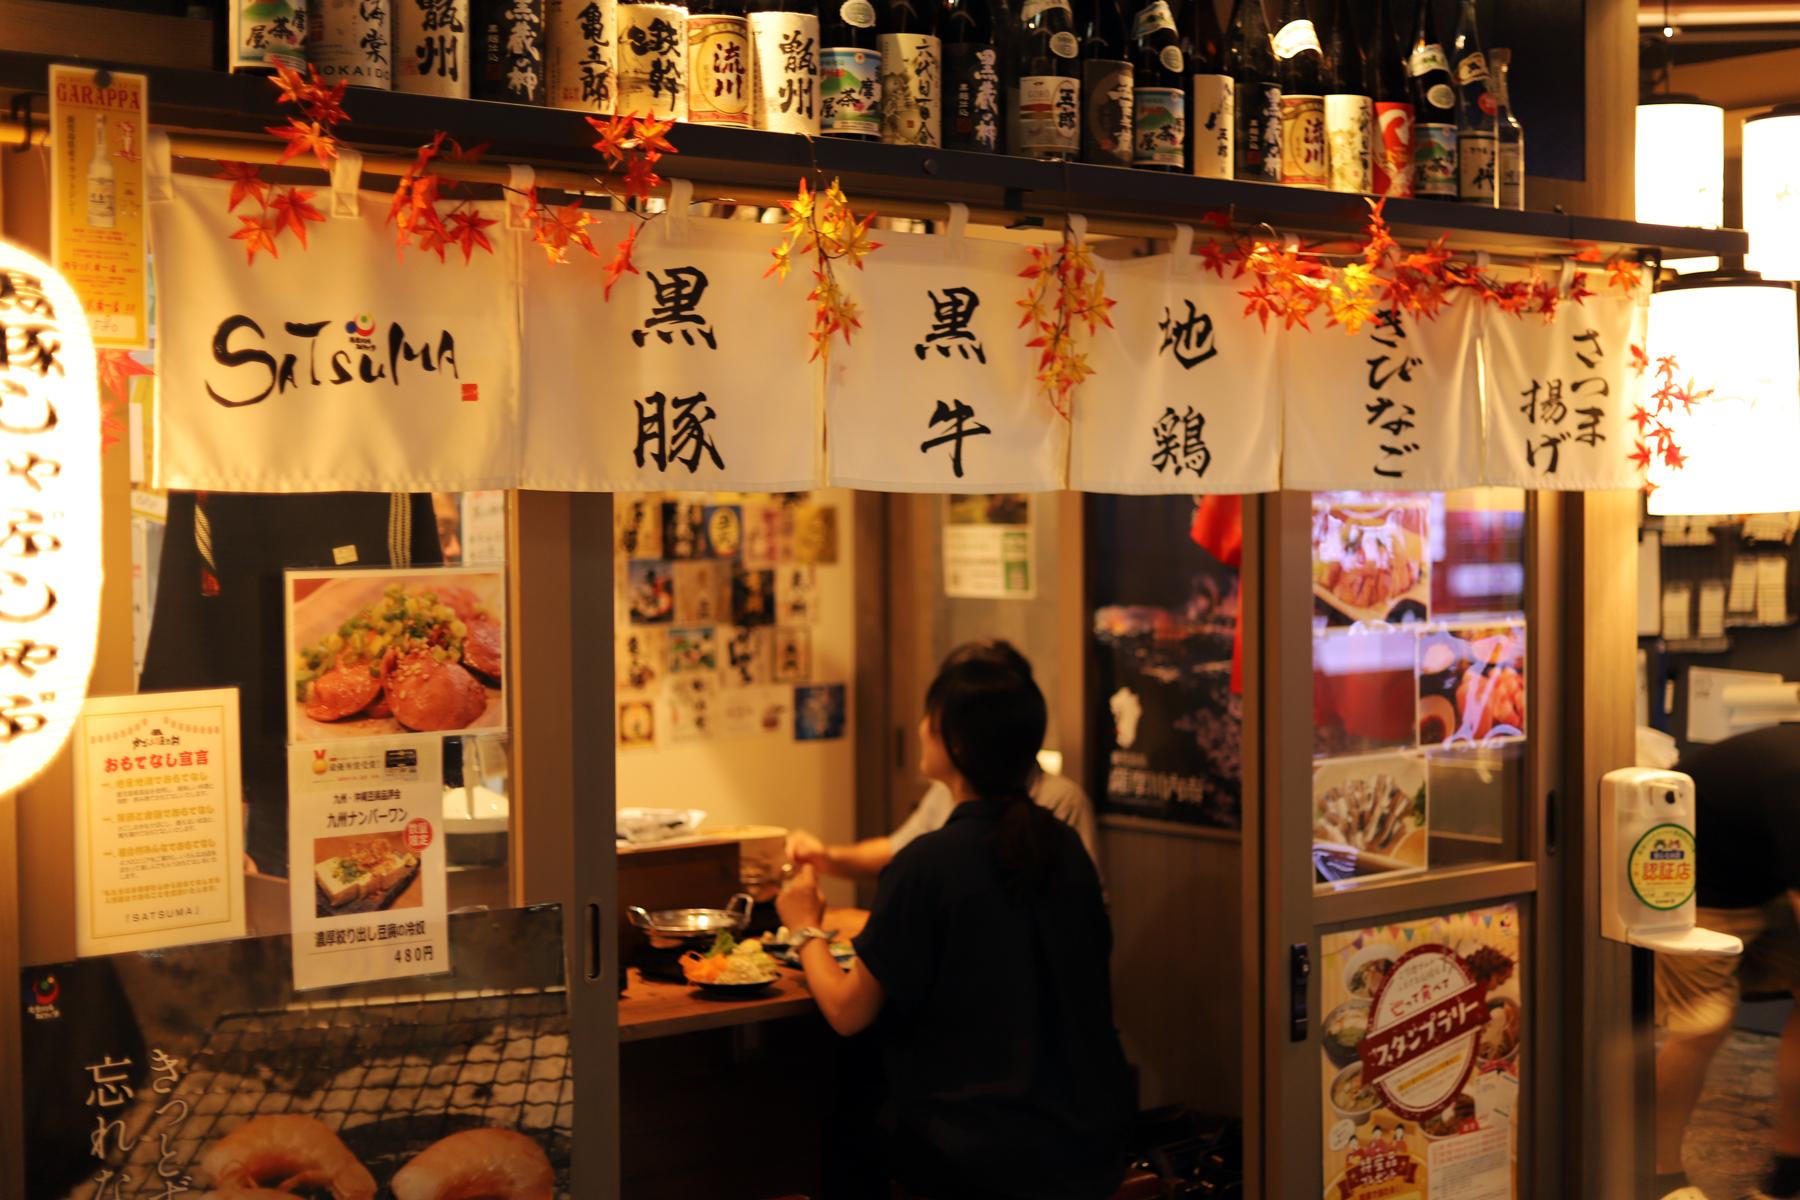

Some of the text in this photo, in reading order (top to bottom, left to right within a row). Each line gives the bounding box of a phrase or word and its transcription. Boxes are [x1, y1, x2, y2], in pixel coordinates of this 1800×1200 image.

[57, 82, 141, 111] GARAPPA
[713, 41, 744, 99] 流川
[631, 266, 726, 473] 黒豚
[914, 286, 992, 478] 黒牛
[1152, 298, 1218, 478] 地鶏
[1366, 309, 1423, 478] きびなご
[1570, 329, 1609, 447] さつま
[104, 750, 209, 773] おもてなし宣言
[326, 808, 408, 829] 九州ナンバーワン
[1642, 862, 1691, 881] 認証店
[394, 946, 434, 963] 480円
[1369, 1001, 1479, 1066] スタンプラリー
